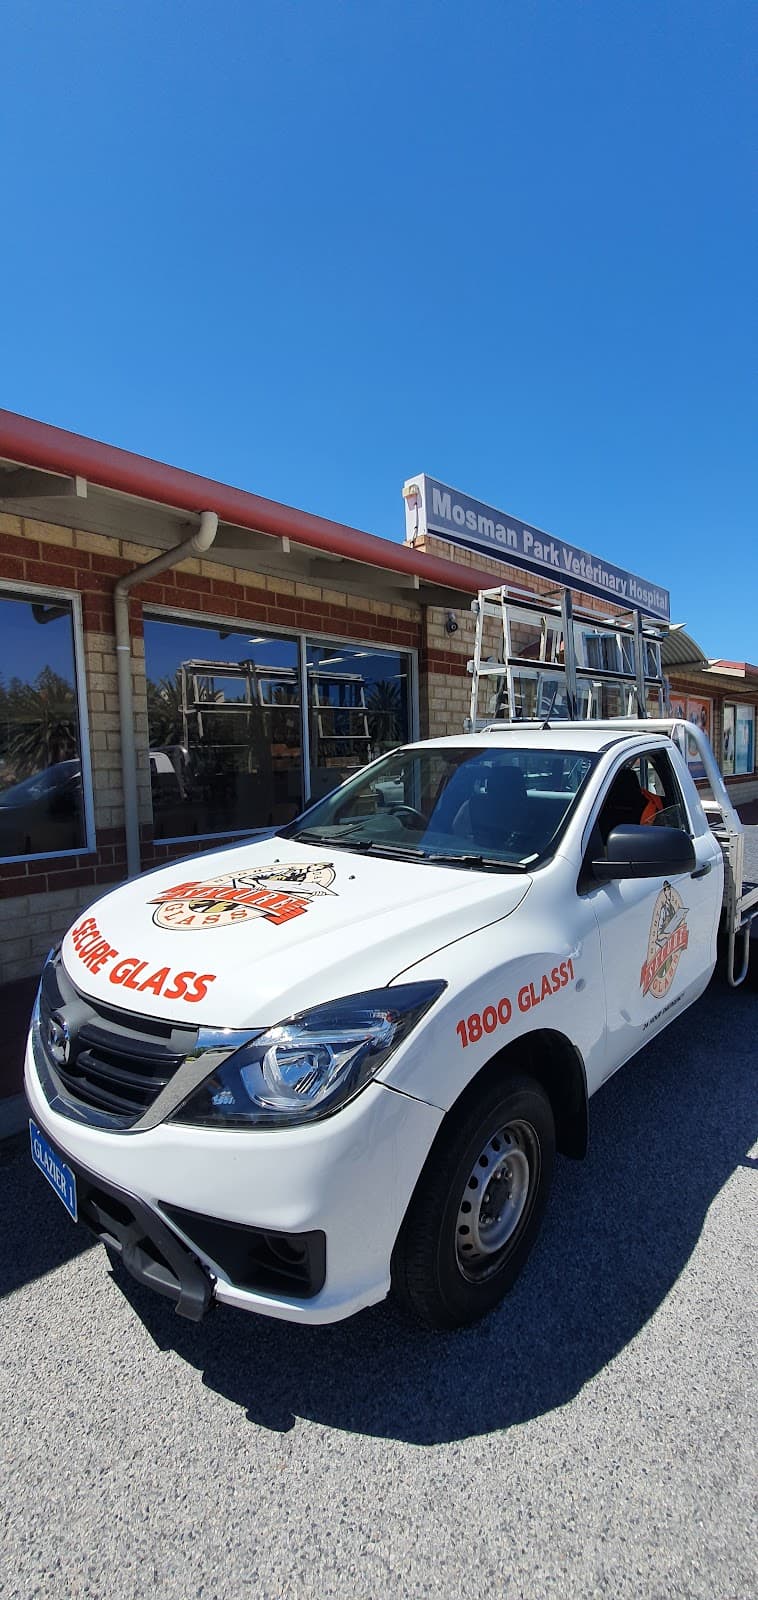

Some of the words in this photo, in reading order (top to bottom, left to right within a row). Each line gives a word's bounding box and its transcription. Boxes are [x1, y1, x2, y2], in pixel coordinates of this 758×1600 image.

[432, 486, 518, 549] Mosman
[523, 529, 560, 565] Park
[562, 547, 627, 597] Veterinary
[629, 578, 668, 610] Hospital
[163, 903, 248, 926] GLASS
[176, 886, 307, 914] SECURE
[71, 917, 120, 975] SECURE
[108, 957, 217, 1003] GLASS
[456, 997, 512, 1049] 1800
[517, 958, 575, 1012] GLASS1
[33, 1139, 67, 1198] GLAZIER
[69, 1186, 74, 1208] 1
